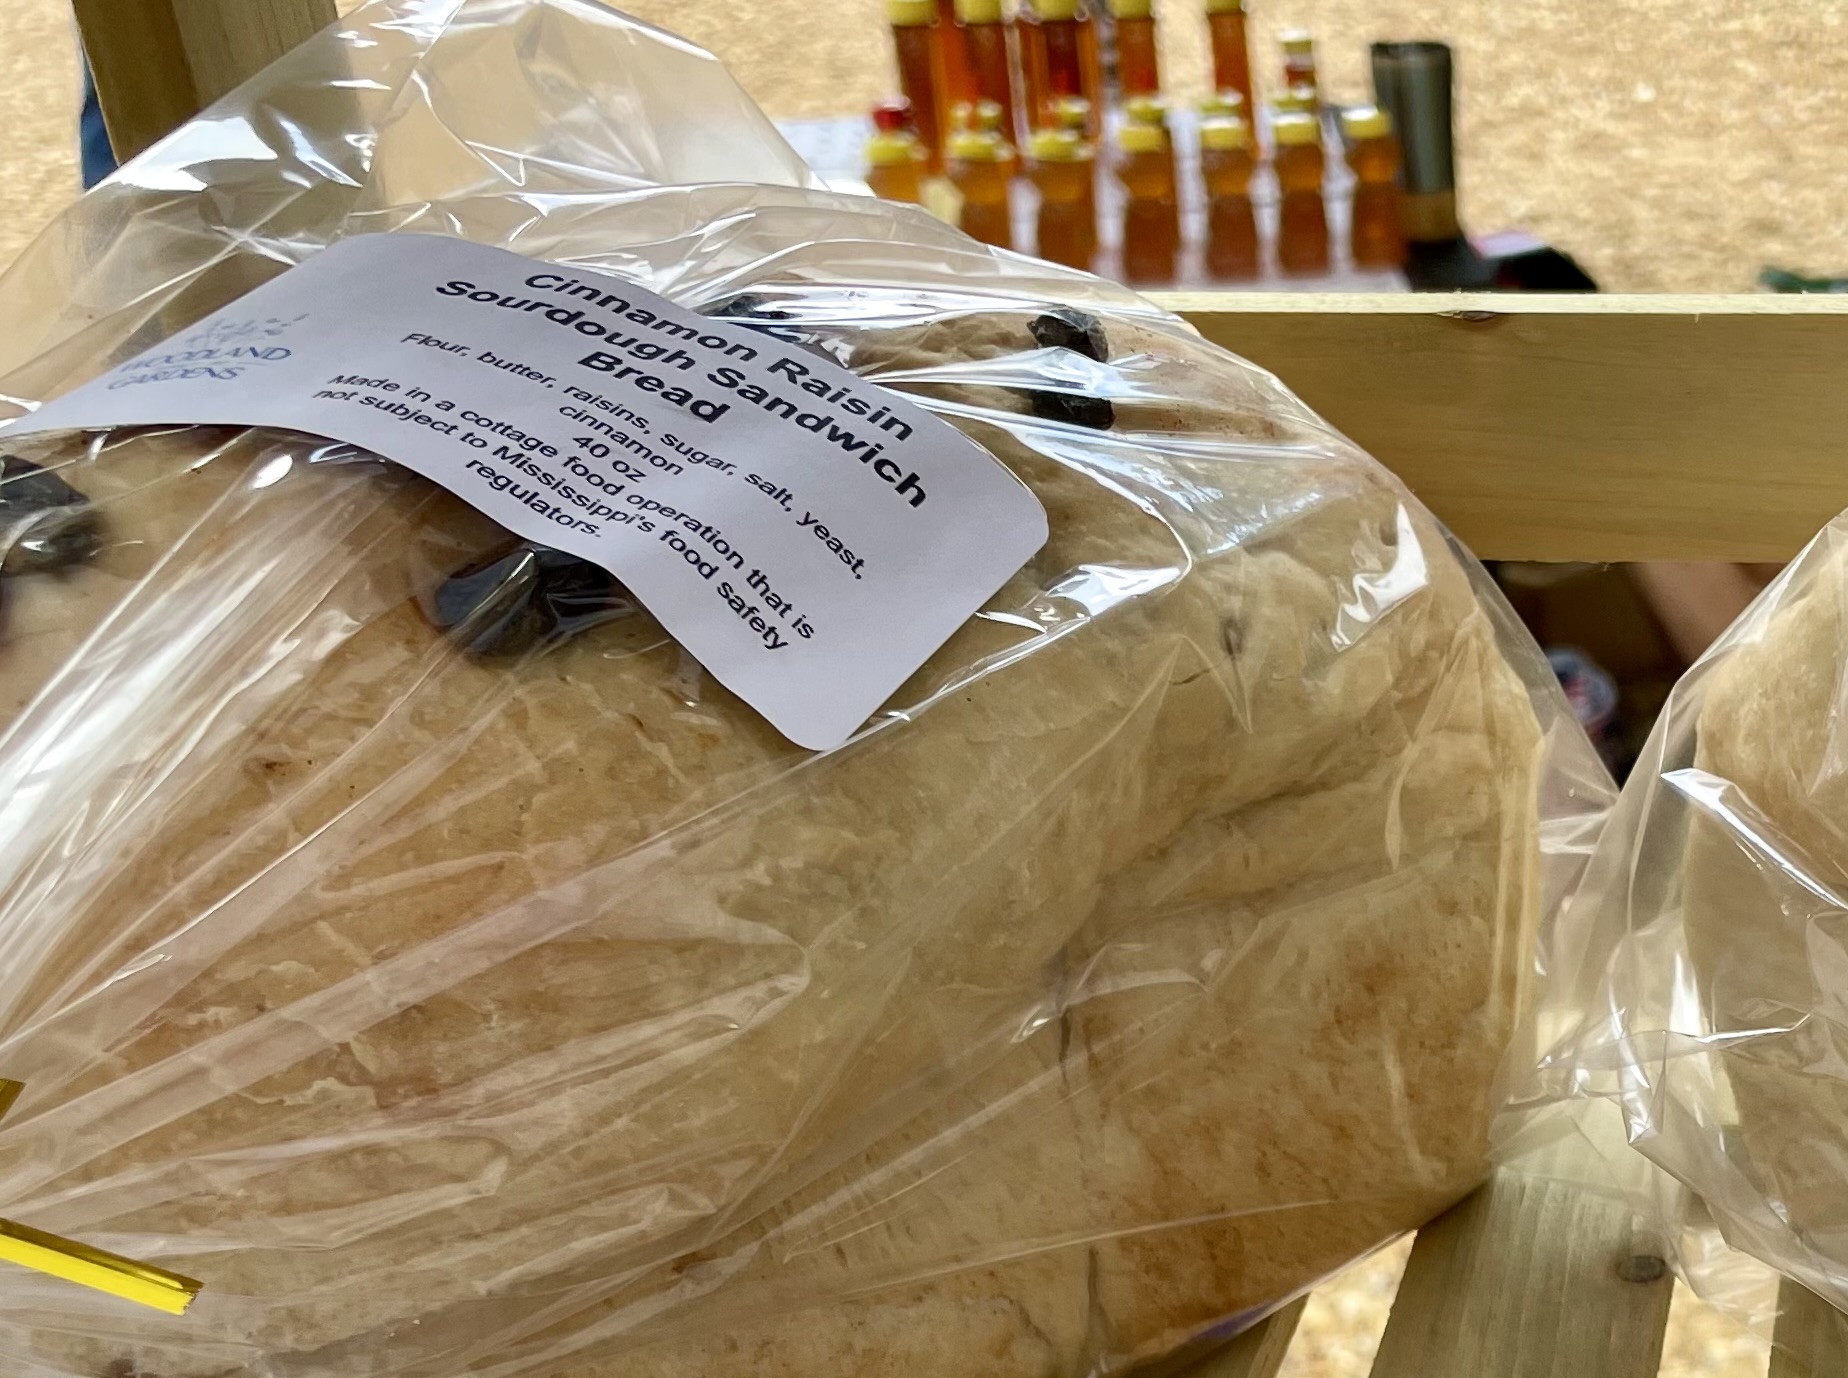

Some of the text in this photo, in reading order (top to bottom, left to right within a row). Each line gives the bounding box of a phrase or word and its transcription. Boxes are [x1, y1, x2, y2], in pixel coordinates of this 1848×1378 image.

[436, 281, 927, 508] Sourdough Sandwich
[525, 274, 913, 442] Cinnamon Raisin
[559, 406, 683, 475] cinnamon
[577, 351, 731, 423] Bread
[312, 390, 788, 651] not subject to Mississippi's food safety
[328, 375, 814, 639] Made in a cottage food operation that is
[401, 333, 865, 580] Flour, butter, raisins, sugar, salt, yeast,
[465, 459, 601, 538] regulators.
[573, 437, 647, 483] 40 oz
